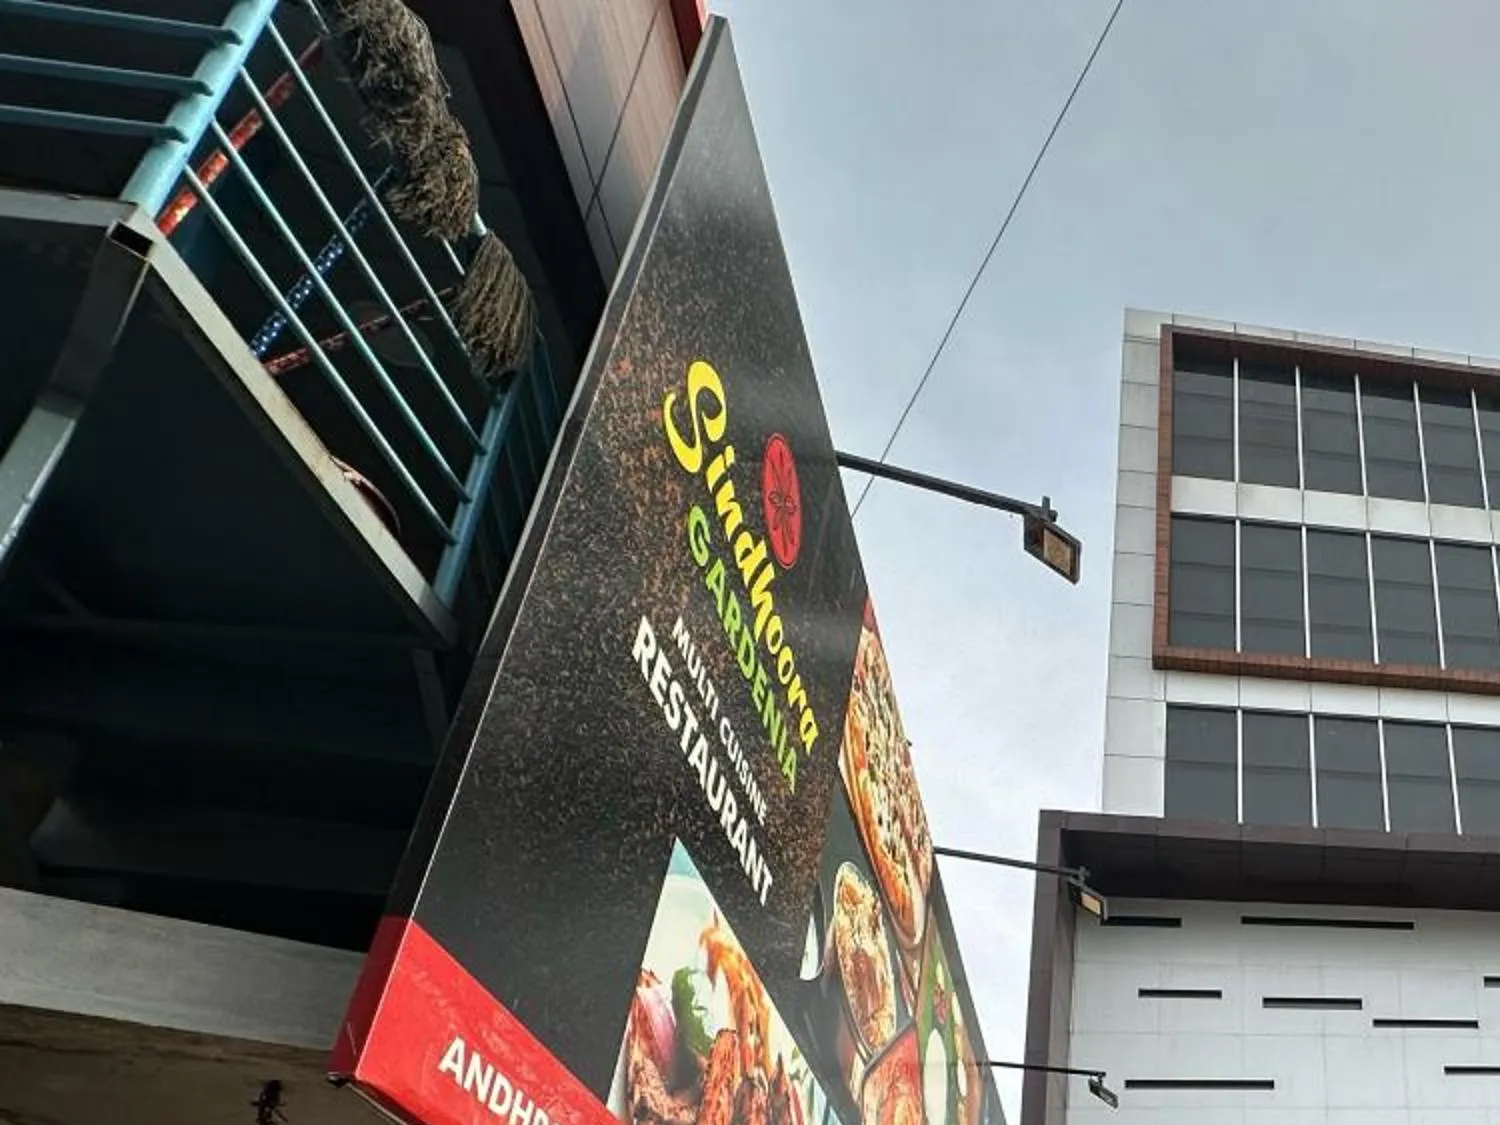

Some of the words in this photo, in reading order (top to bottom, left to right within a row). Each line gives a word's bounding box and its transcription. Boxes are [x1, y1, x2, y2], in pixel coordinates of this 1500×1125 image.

[663, 360, 821, 754] Sindhoora
[687, 505, 799, 793] GARDENIA
[631, 614, 774, 906] RESTAURANT
[671, 616, 720, 718] MULTI
[719, 718, 768, 826] CUISINE
